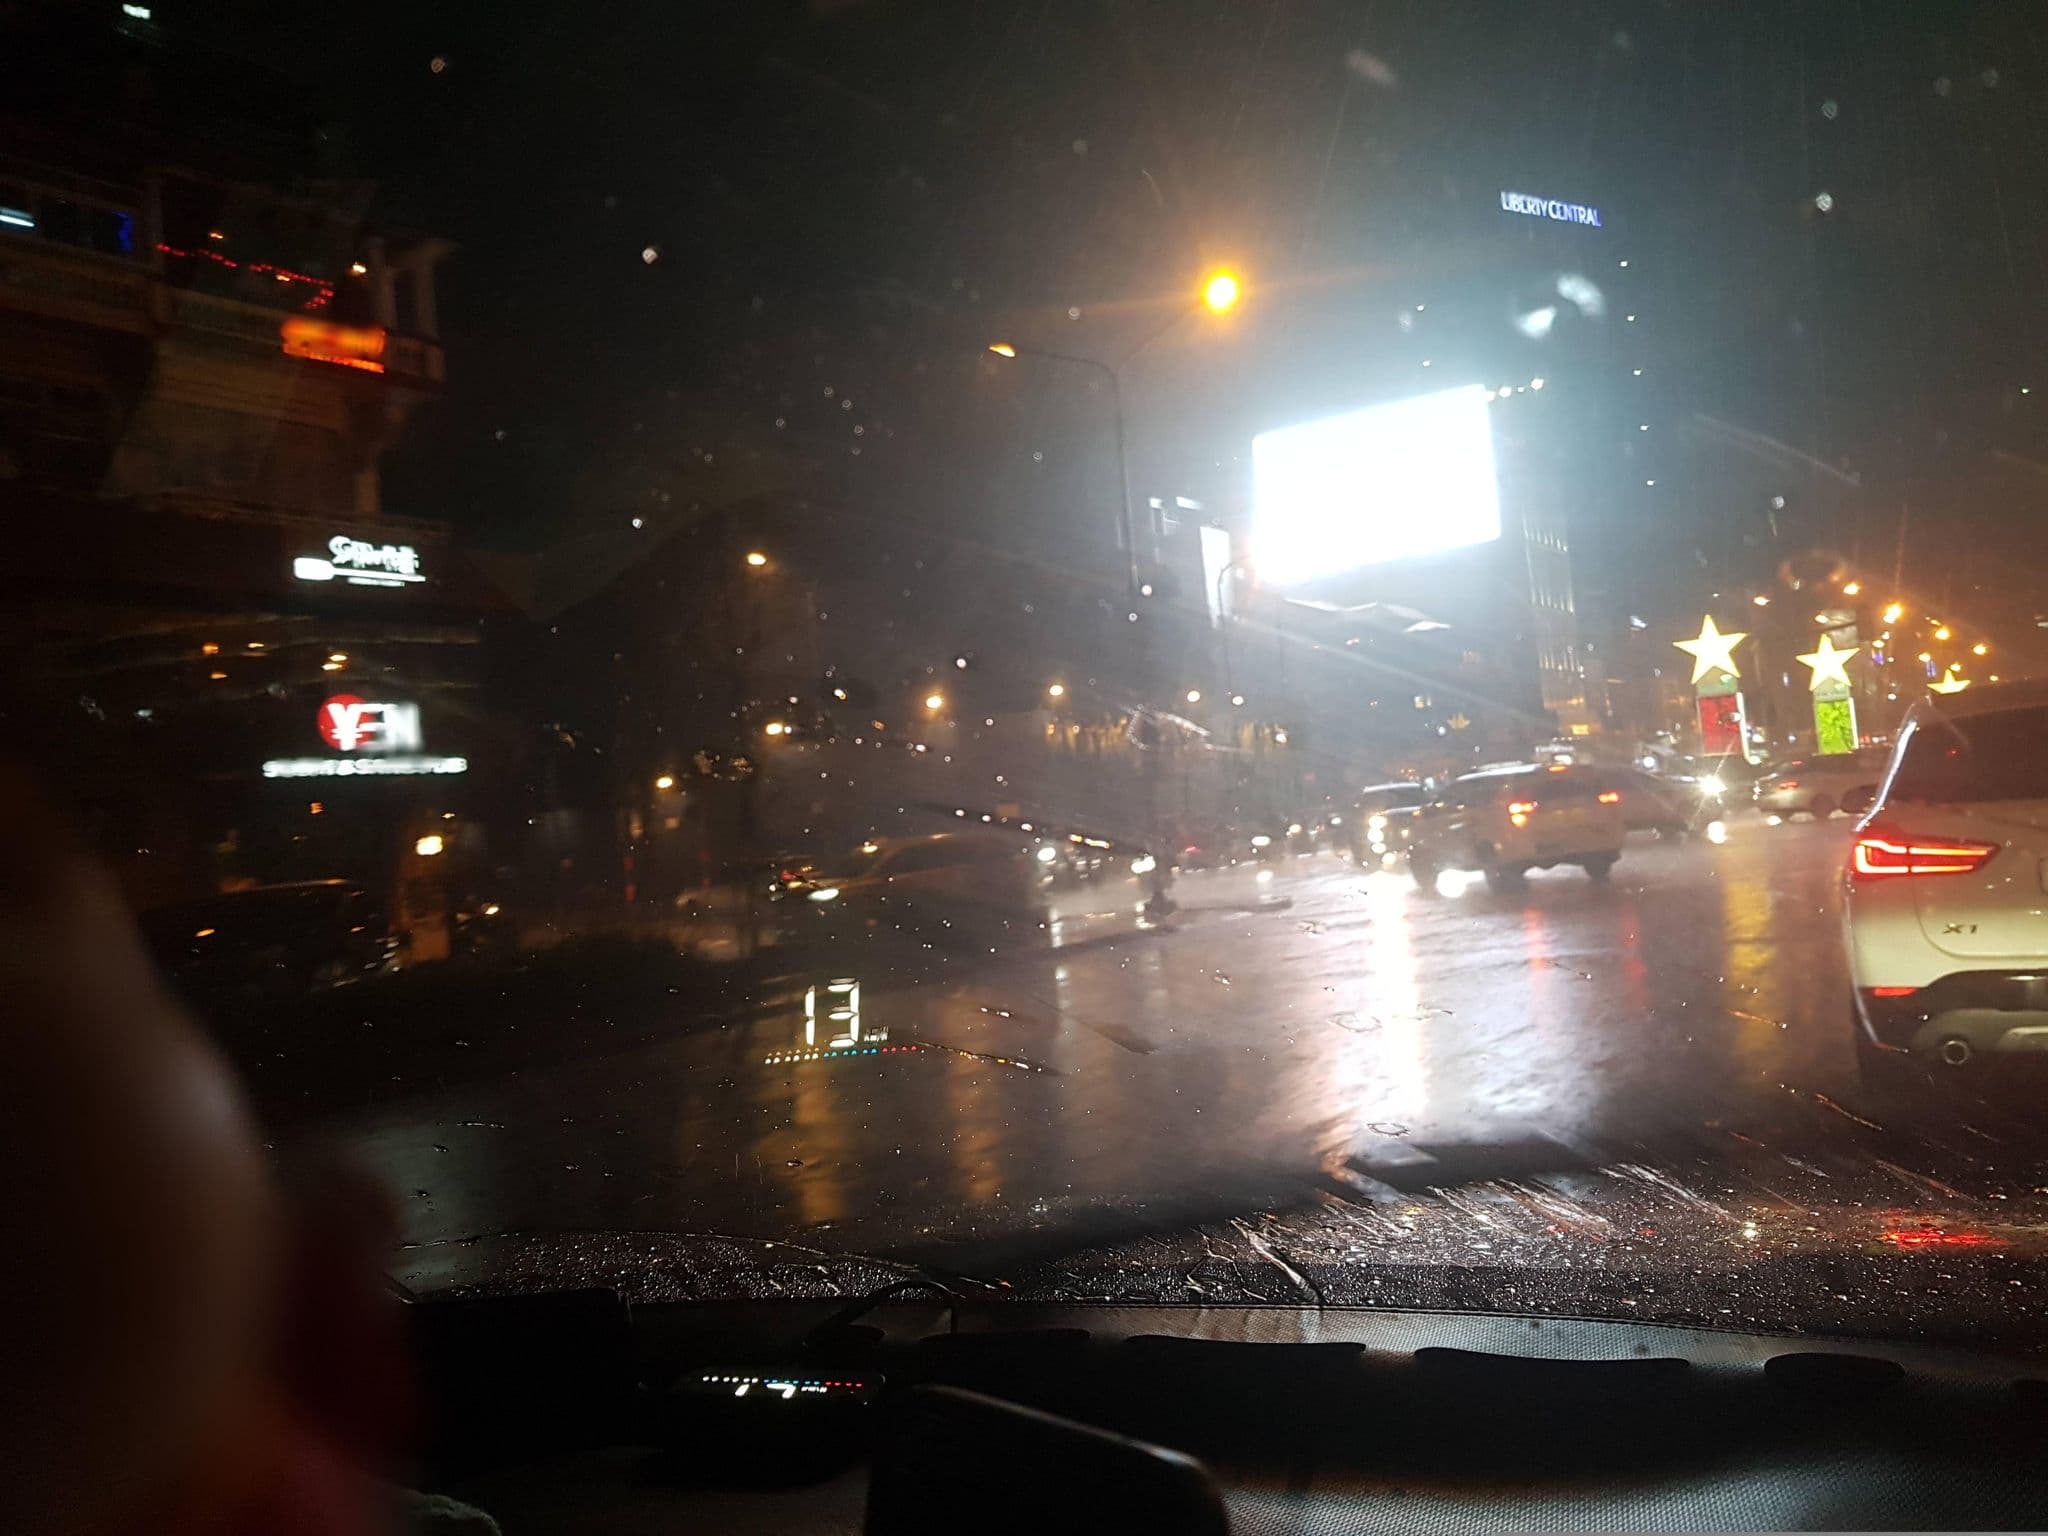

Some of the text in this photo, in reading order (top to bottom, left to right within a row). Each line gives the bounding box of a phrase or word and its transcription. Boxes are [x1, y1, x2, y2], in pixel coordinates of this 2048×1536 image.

[1501, 191, 1602, 227] LIBERTY CENTRAL
[805, 978, 860, 1048] 13
